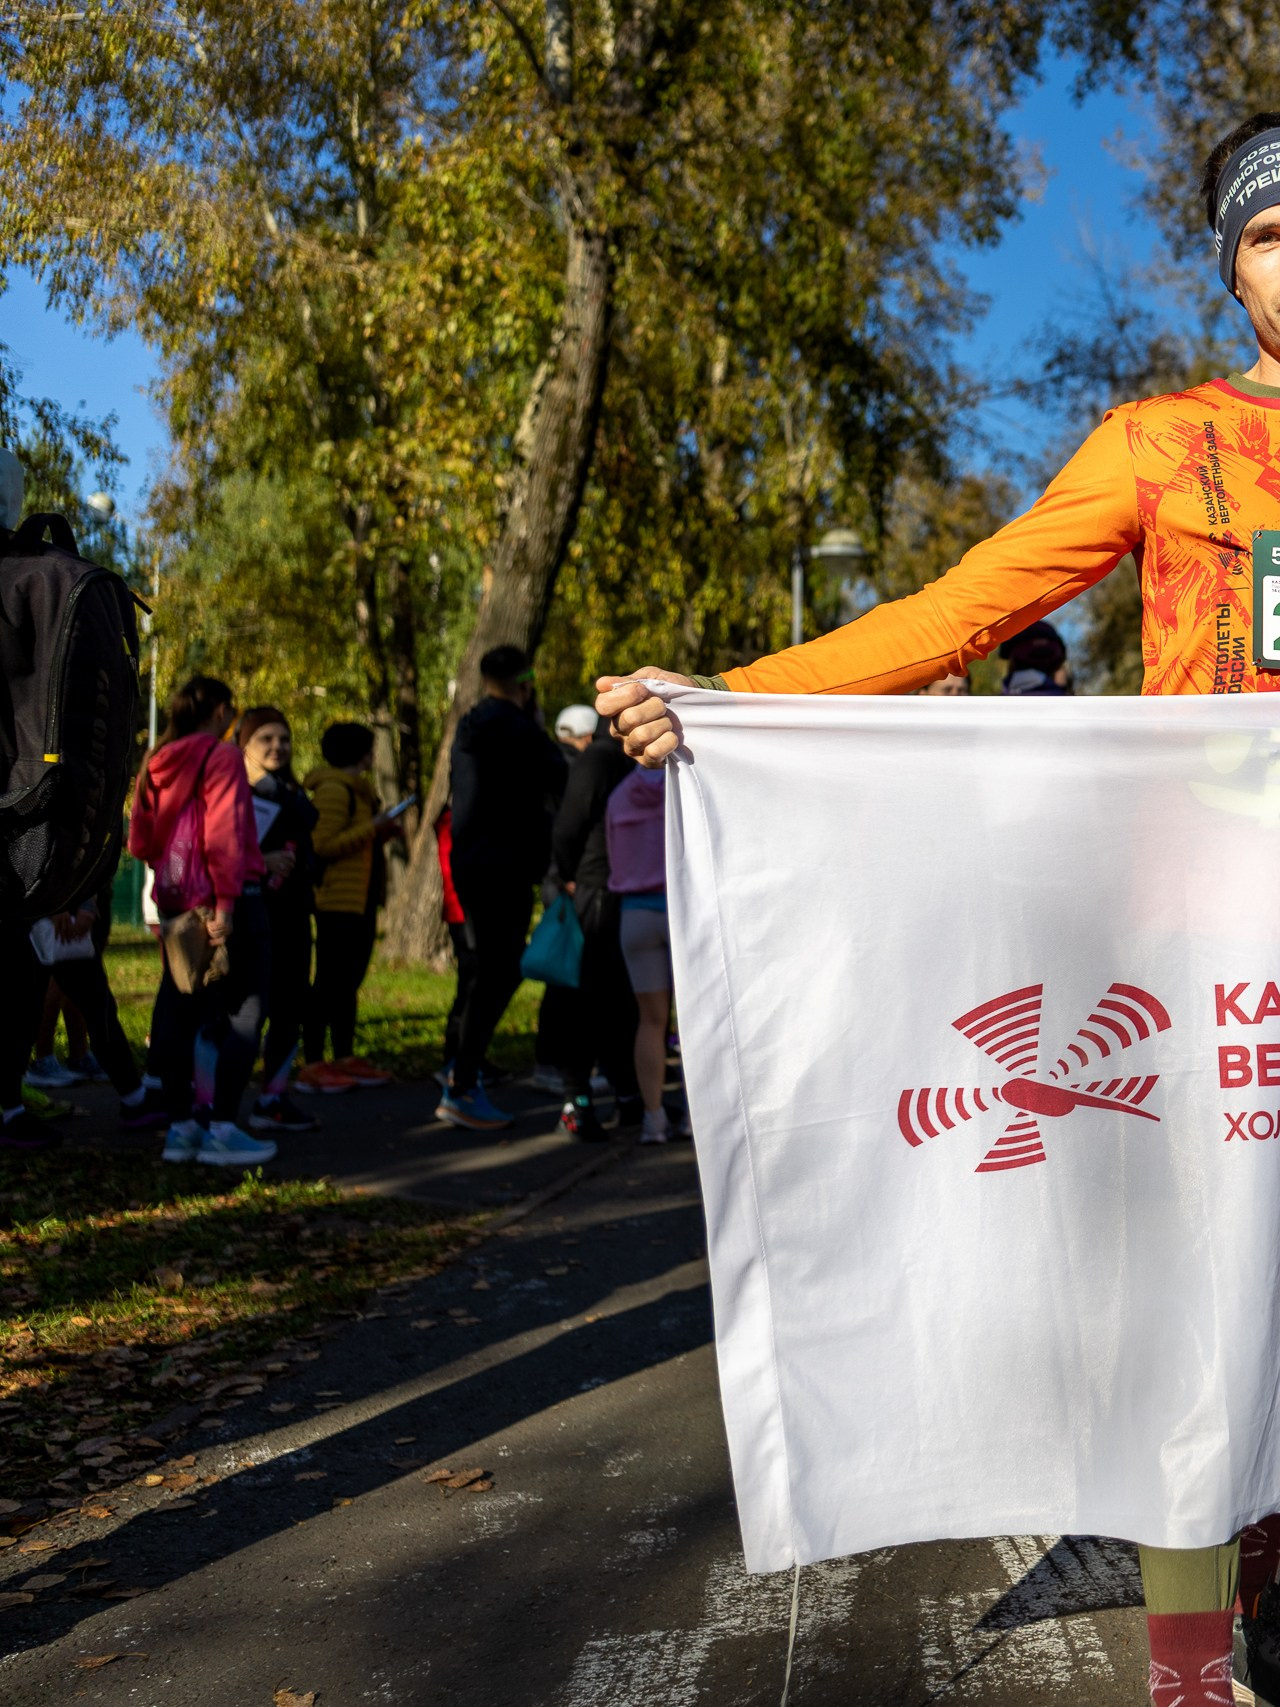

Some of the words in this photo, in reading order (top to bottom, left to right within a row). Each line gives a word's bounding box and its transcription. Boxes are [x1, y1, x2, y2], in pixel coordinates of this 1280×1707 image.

[1203, 420, 1218, 451] ЗАВОД
[1195, 465, 1218, 526] КАЗАНСКИЙ
[1207, 452, 1231, 525] ВЕРТОЛЕТНЫЙ
[1213, 603, 1231, 694] ЕРТОЛЕТЫ
[1227, 636, 1245, 694] ОССИИ
